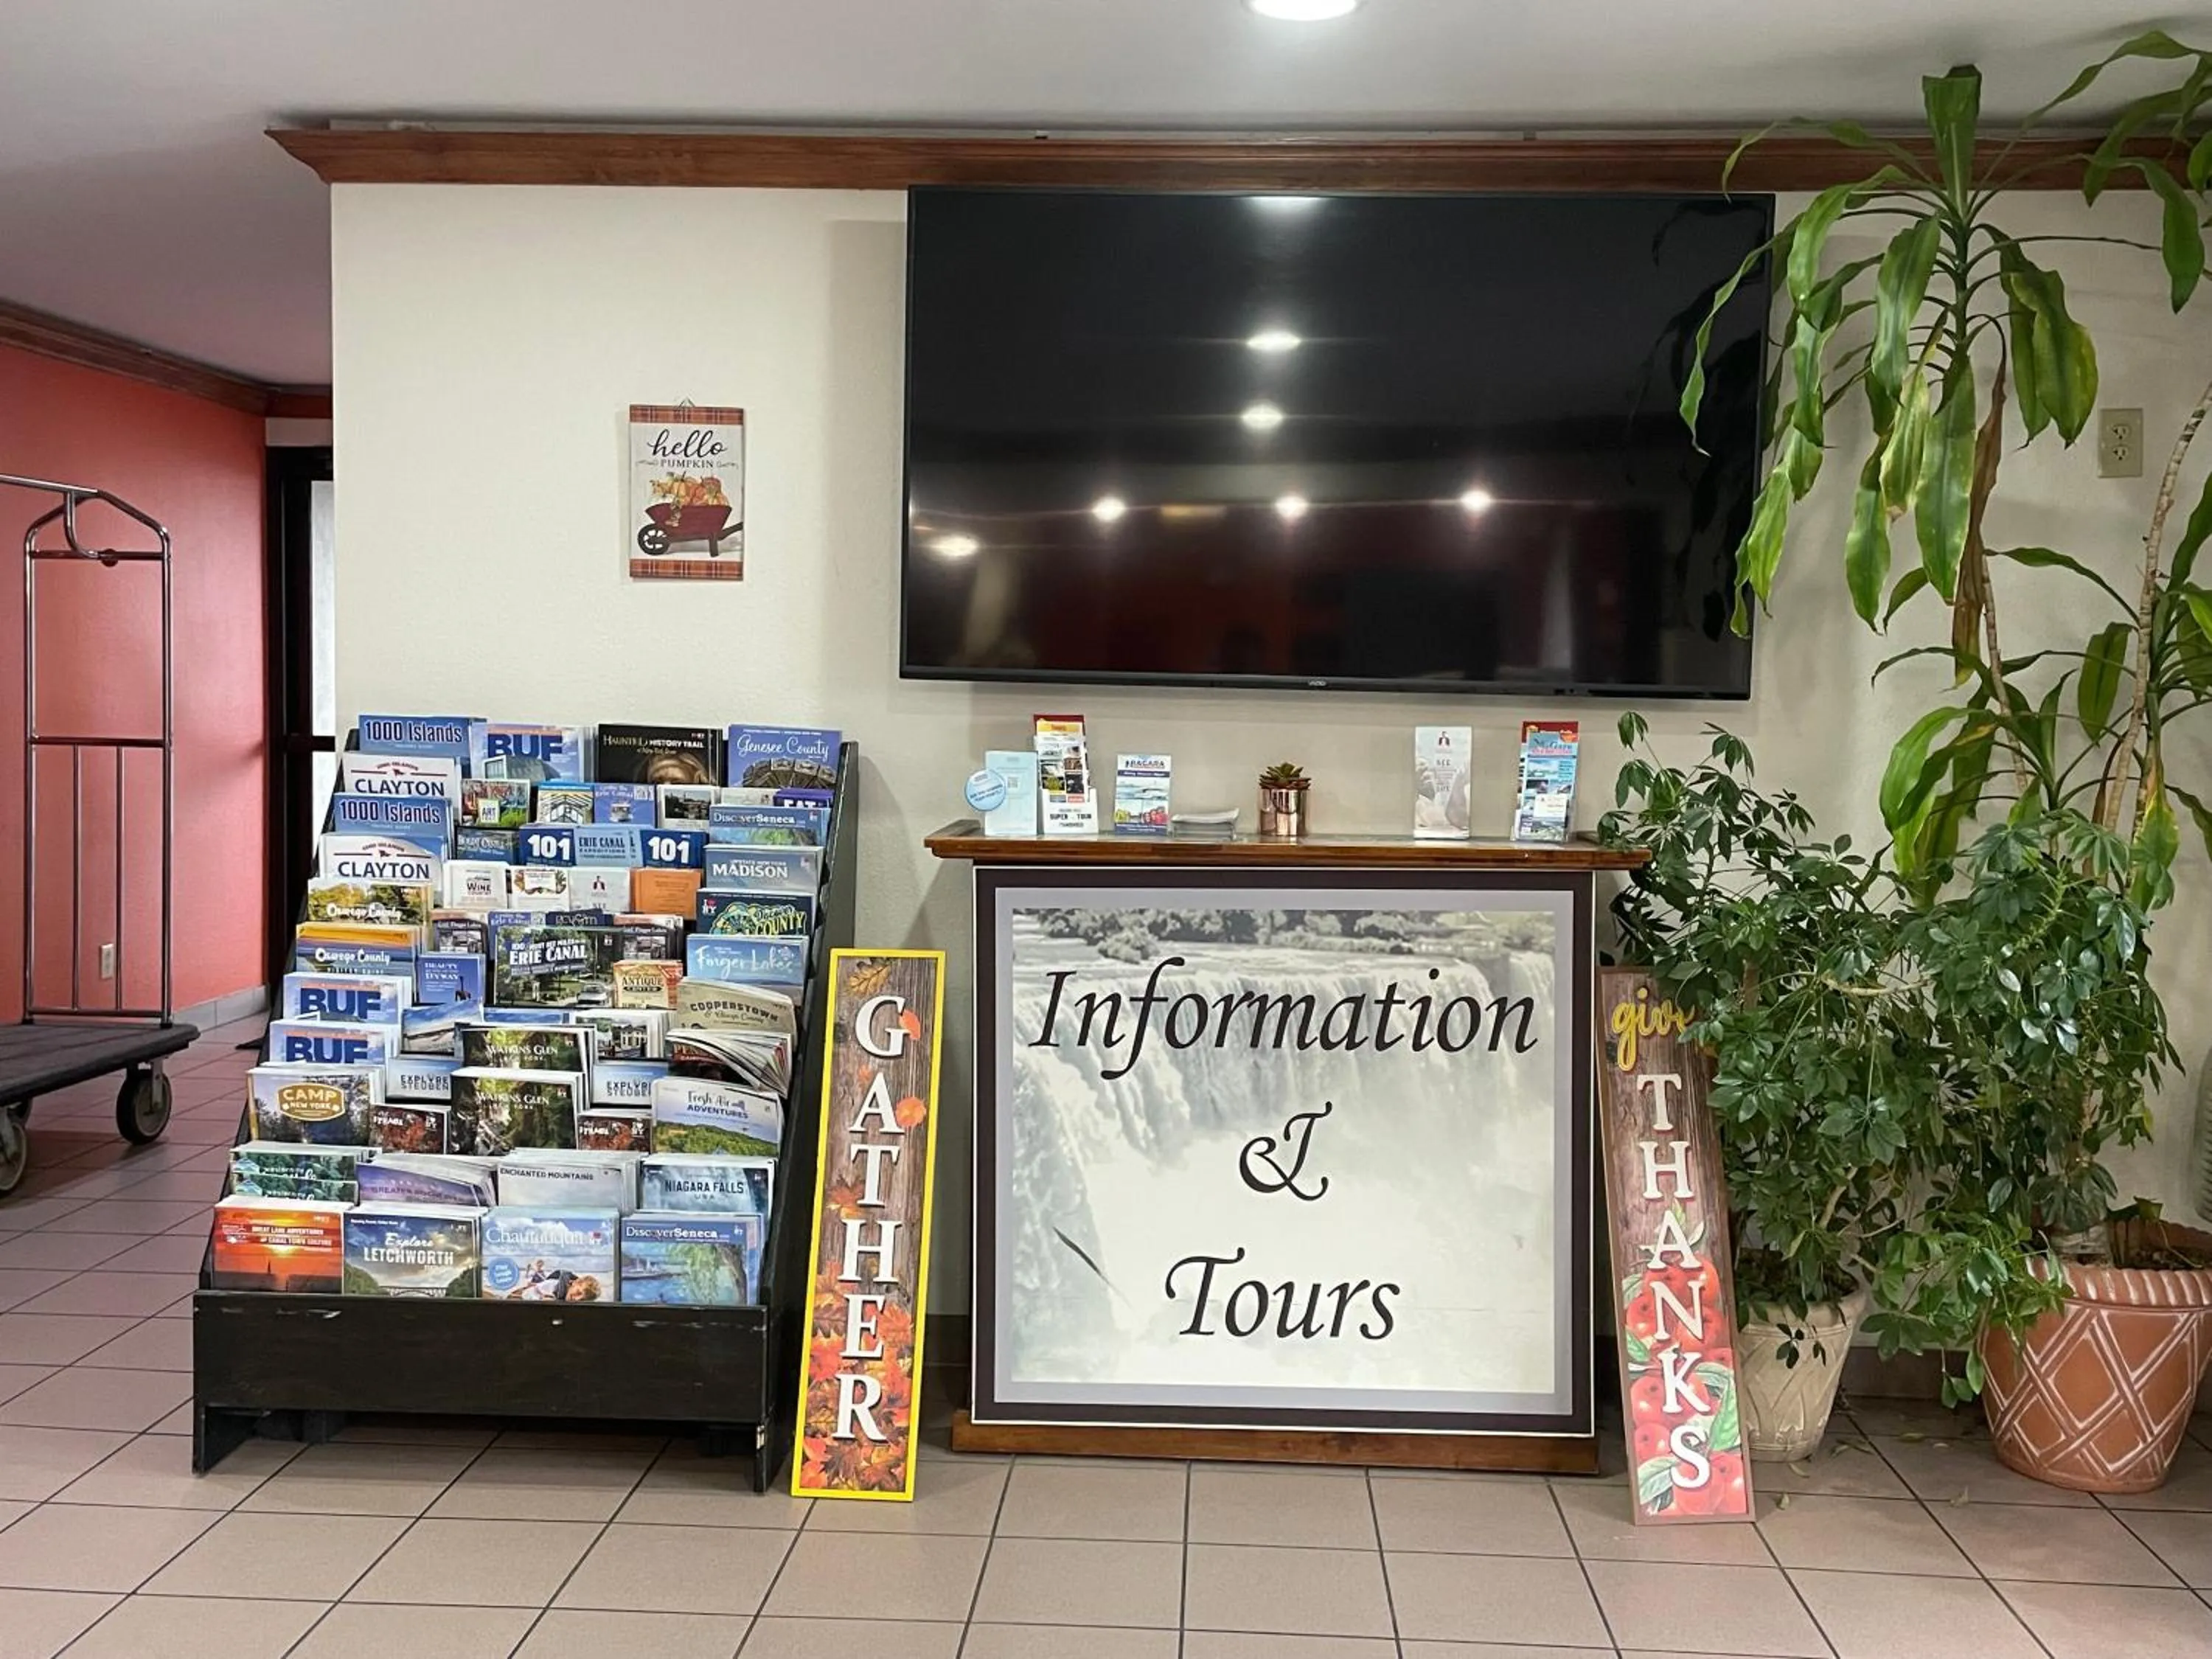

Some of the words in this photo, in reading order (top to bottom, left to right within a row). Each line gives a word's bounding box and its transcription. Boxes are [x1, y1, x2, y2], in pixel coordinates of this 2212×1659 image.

[647, 428, 728, 458] hello
[661, 459, 714, 469] PUMPKIN
[366, 720, 403, 741] 1000
[407, 721, 463, 743] Islands
[488, 734, 563, 761] BUF
[649, 740, 681, 748] HISTORY
[737, 734, 783, 757] Genesee
[786, 737, 830, 762] County
[355, 779, 445, 796] CLAYTON
[340, 800, 379, 821] 1000
[384, 801, 441, 824] Islands
[527, 835, 570, 860] 101
[579, 837, 597, 847] ERIE
[599, 837, 625, 848] CANAL
[648, 836, 690, 863] 101
[338, 861, 430, 879] CLAYTON
[712, 863, 788, 878] MADISON
[316, 948, 355, 964] Oswego
[358, 948, 391, 966] County
[510, 951, 542, 964] ERIE
[546, 945, 587, 961] CANAL
[695, 945, 746, 980] Finger
[751, 946, 793, 973] Lakes
[300, 988, 381, 1019] BUF
[690, 1001, 779, 1021] COOPERSTOWN
[1028, 956, 1538, 1079] Information
[286, 1037, 368, 1063] BUF
[282, 1089, 338, 1102] CAMP
[688, 1091, 713, 1105] Fresh
[686, 1105, 749, 1119] ADVENTURES
[1239, 1101, 1333, 1202] &
[500, 1167, 546, 1178] ENCHANTED
[548, 1172, 594, 1180] MOUNTAINS
[665, 1180, 710, 1192] NIAGARA
[713, 1182, 744, 1194] FALLS
[835, 995, 909, 1442] GATHER
[385, 1232, 434, 1248] Explore
[364, 1247, 454, 1265] LETCHWORTH
[1636, 1074, 1711, 1489] THANKS
[1165, 1247, 1400, 1340] Tours
